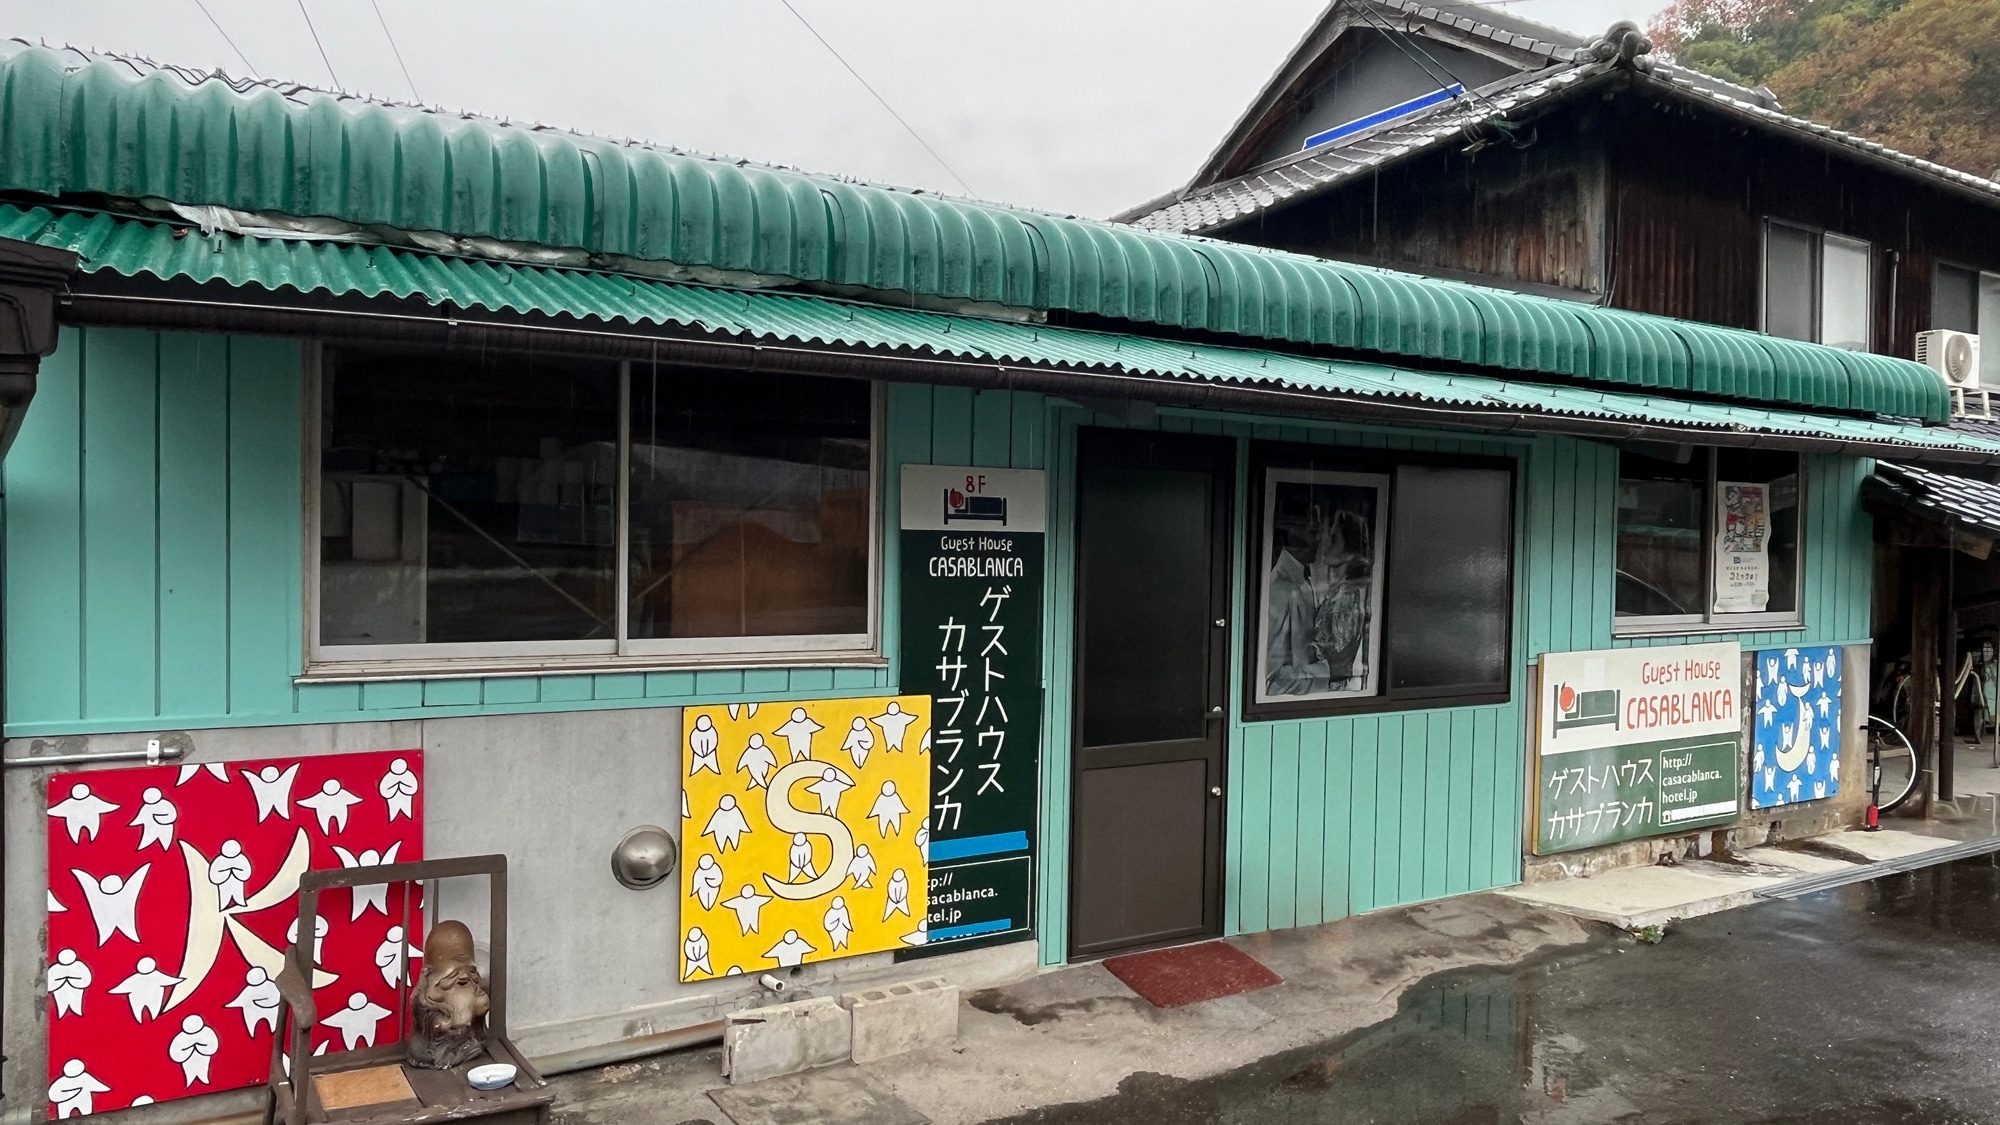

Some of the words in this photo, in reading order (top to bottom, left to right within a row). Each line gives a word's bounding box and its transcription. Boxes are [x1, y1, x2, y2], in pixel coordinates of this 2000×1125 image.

[941, 536, 975, 551] Guest
[979, 536, 1013, 552] House
[929, 557, 1023, 577] CASABLANCA
[976, 585, 1011, 796] ゲストハウス
[1642, 661, 1680, 685] Guest
[1684, 659, 1721, 681] House
[934, 616, 969, 831] カサブランカ
[1626, 688, 1733, 730] CASABLANCA
[1548, 758, 1654, 800] ゲストハウス
[1662, 753, 1693, 771] http://
[1662, 769, 1722, 787] casacablanca.
[1662, 788, 1698, 804] hotel.jp
[762, 759, 856, 900] S
[1547, 796, 1654, 840] カサブランカ
[158, 825, 340, 1016] K
